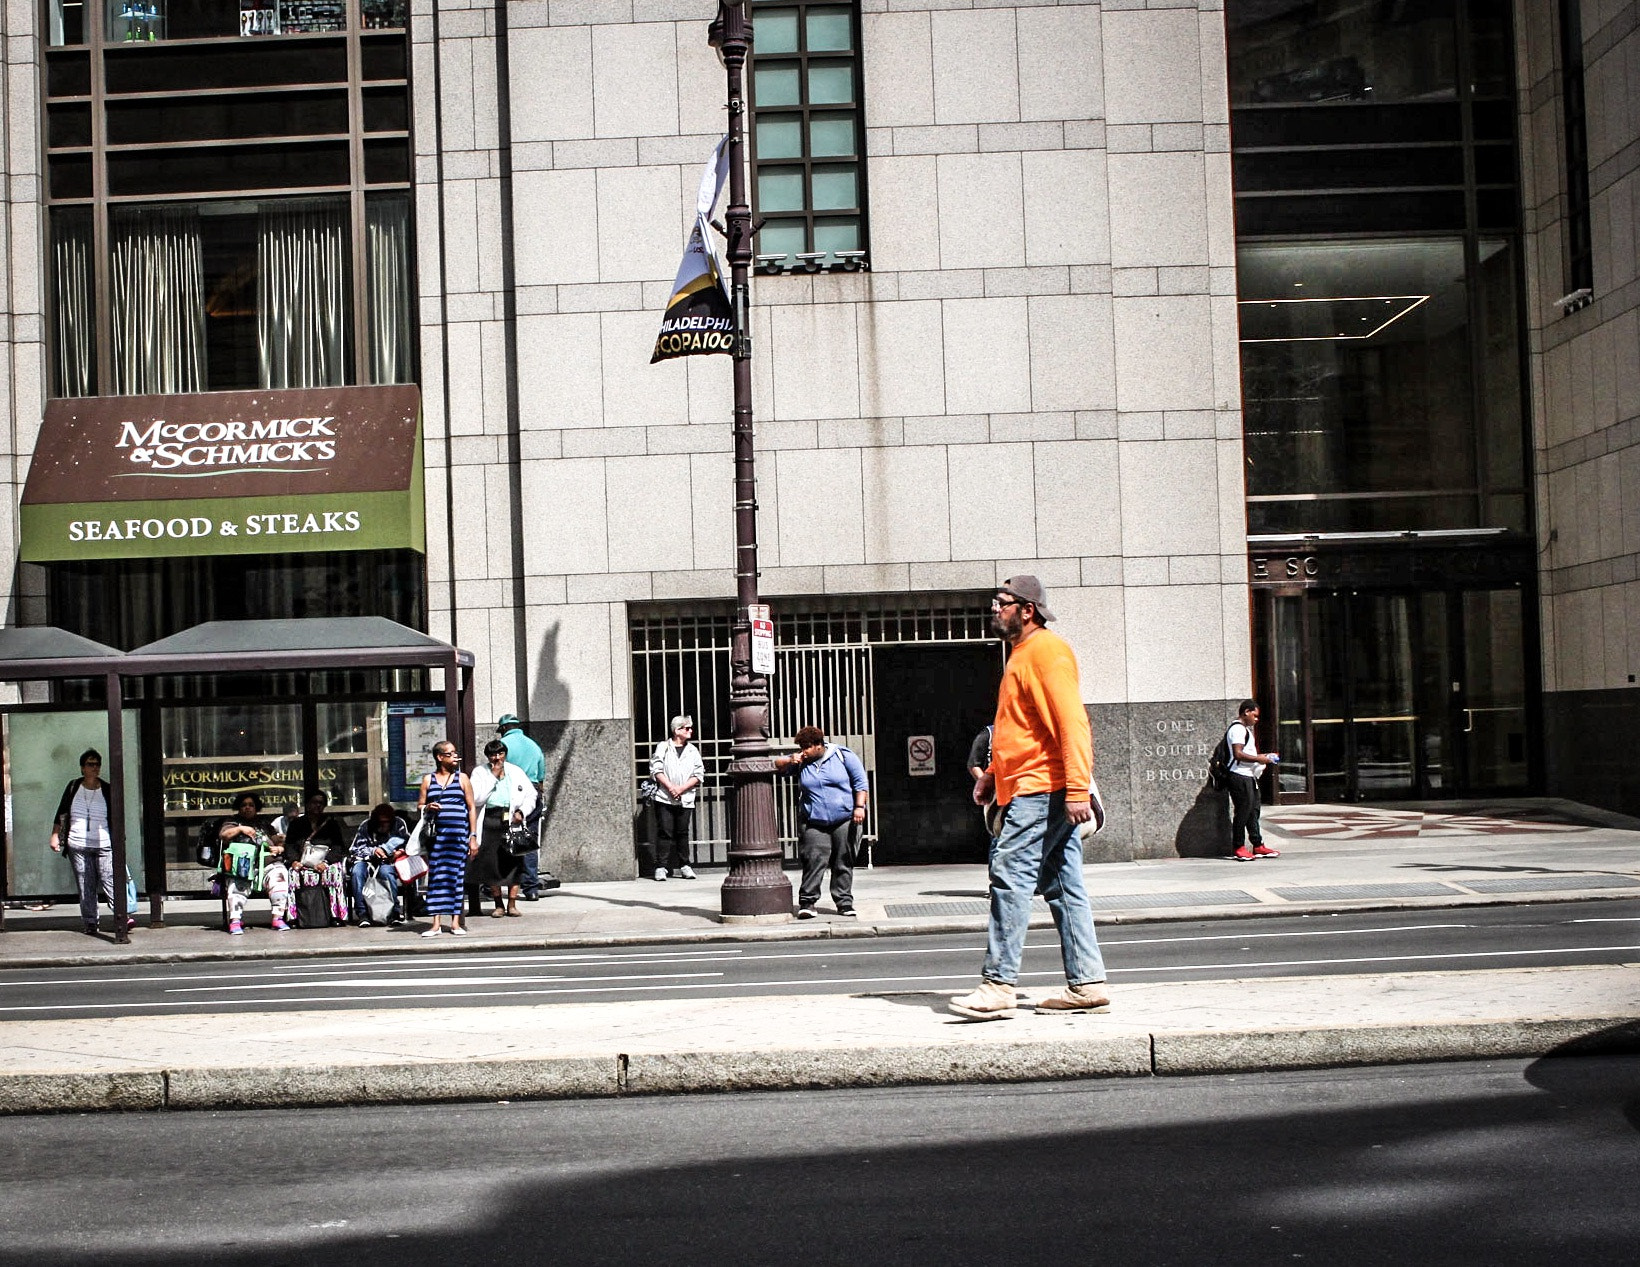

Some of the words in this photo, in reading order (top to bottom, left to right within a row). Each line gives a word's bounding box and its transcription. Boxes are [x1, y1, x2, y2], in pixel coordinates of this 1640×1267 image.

[660, 316, 733, 333] HILADELPHI
[115, 416, 336, 448] McCORMICK
[129, 447, 155, 463] &
[150, 440, 336, 468] SCHMICK'S
[68, 517, 213, 541] SEAFOOD
[219, 520, 240, 537] &
[246, 510, 361, 535] STEAKS
[758, 641, 769, 650] BUS
[756, 652, 771, 662] ZONE
[1156, 720, 1196, 732] ONE
[1144, 743, 1208, 757] SOUTH
[1146, 768, 1209, 781] BROAD
[190, 796, 237, 806] SEAFOO
